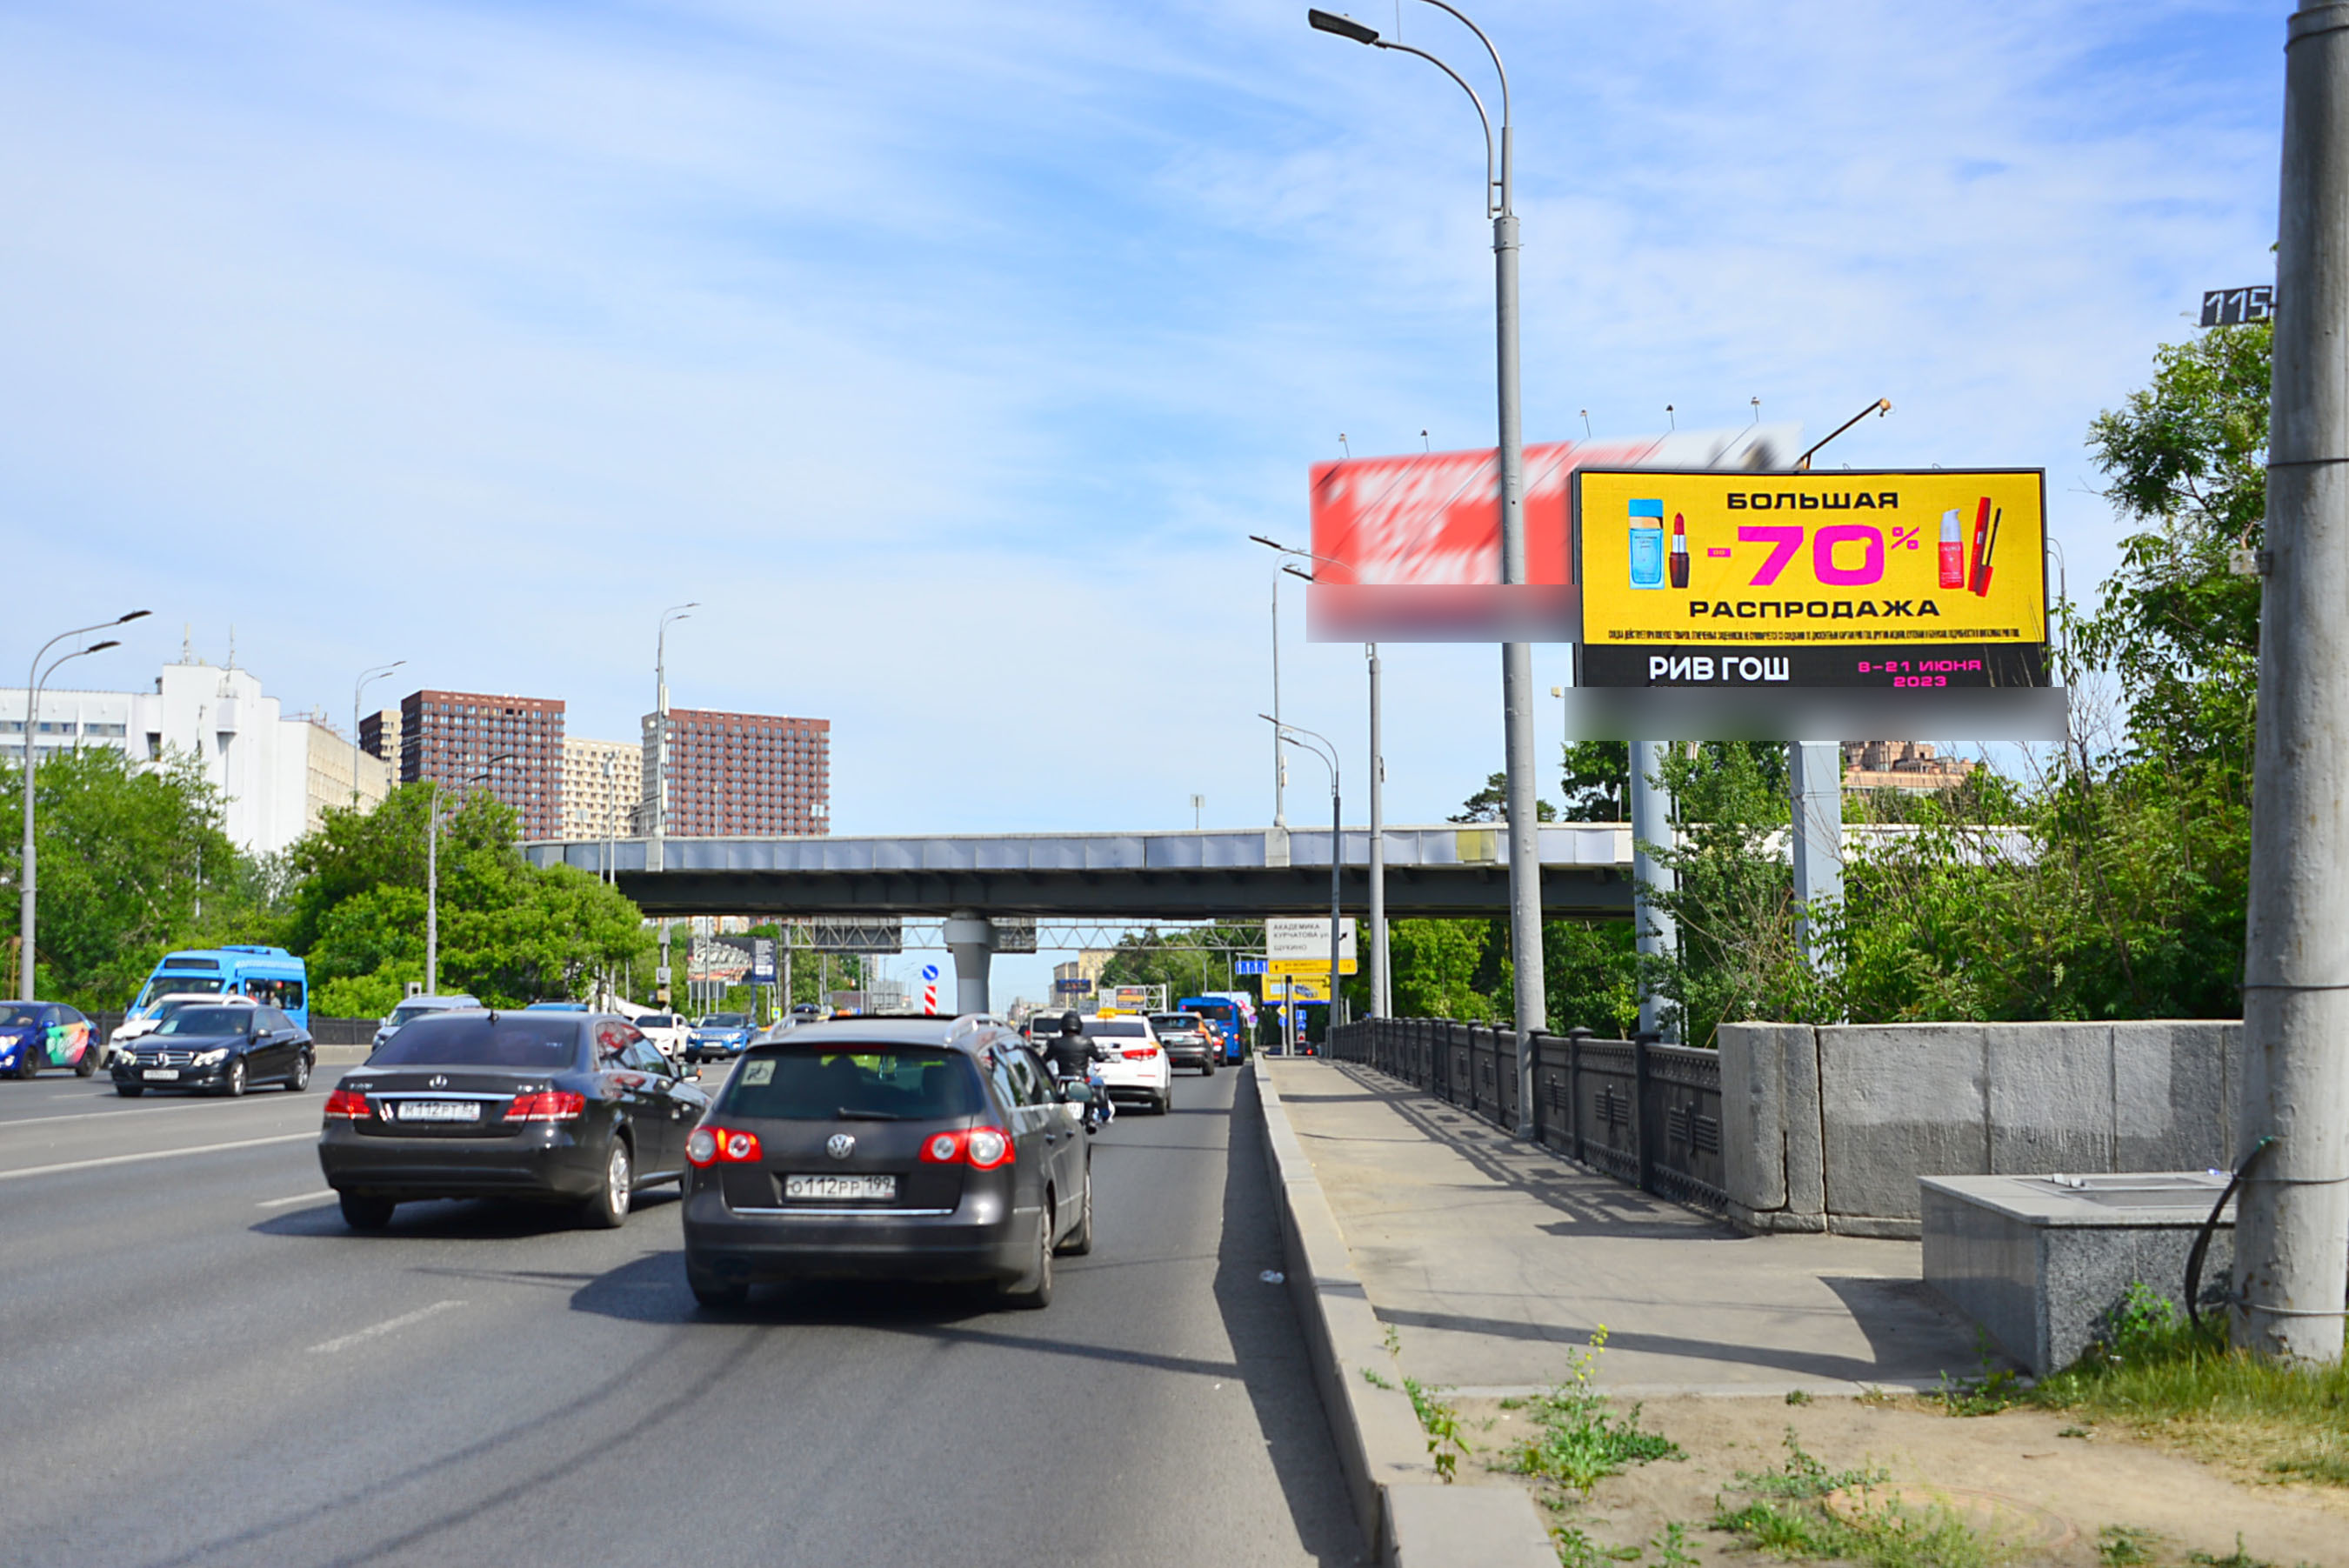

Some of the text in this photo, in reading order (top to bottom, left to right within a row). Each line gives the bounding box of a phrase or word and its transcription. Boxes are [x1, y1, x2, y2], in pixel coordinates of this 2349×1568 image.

[2206, 288, 2270, 324] 115
[1726, 492, 1899, 510] БОЛЬШАЯ
[1689, 600, 1940, 618] РАСПРОДАЖА
[1649, 656, 1790, 681] РИВ ГОШ
[1919, 659, 1982, 672] ИЮНЯ
[1893, 676, 1947, 687] 2023
